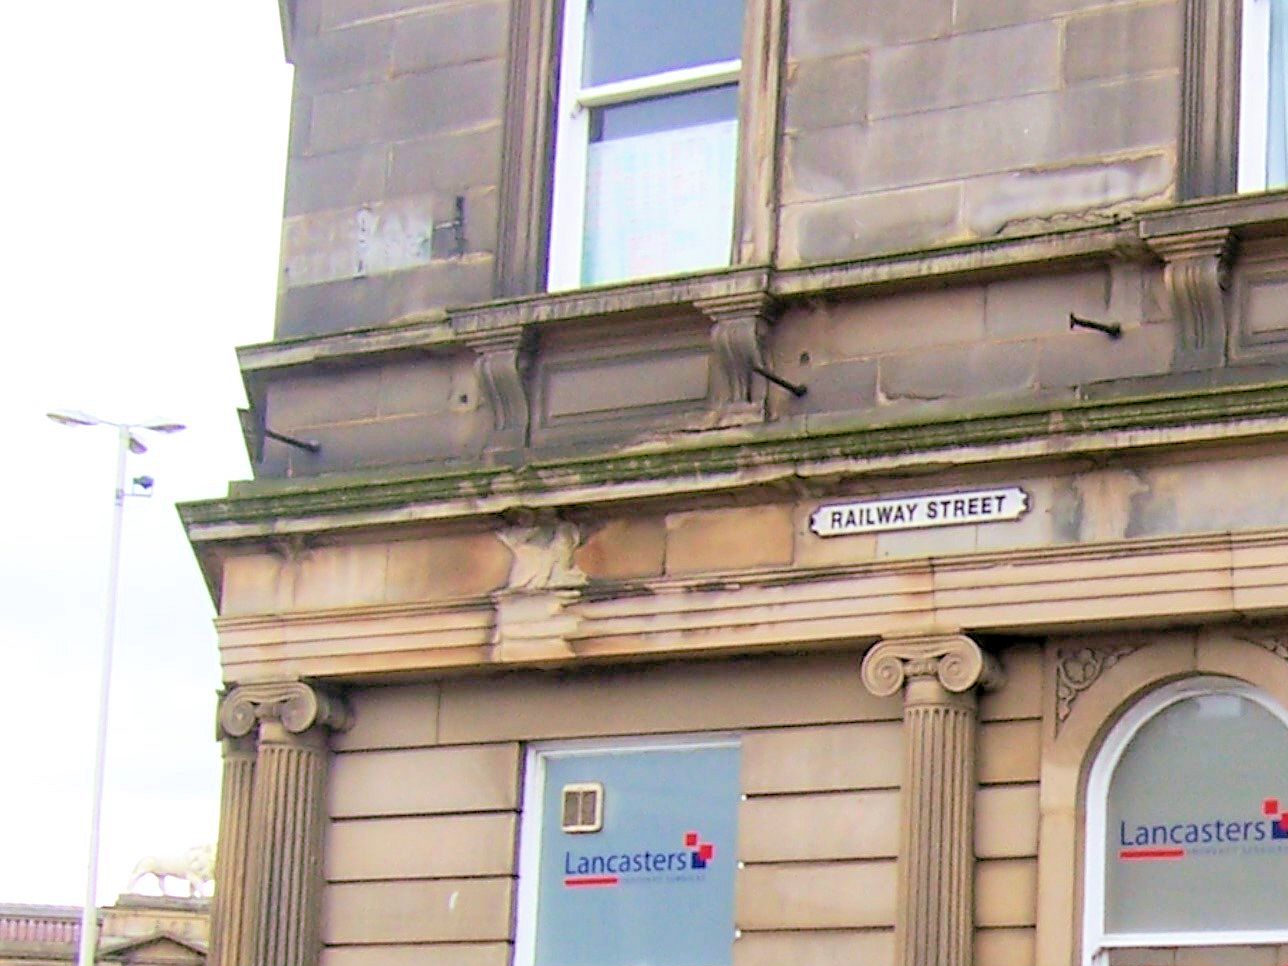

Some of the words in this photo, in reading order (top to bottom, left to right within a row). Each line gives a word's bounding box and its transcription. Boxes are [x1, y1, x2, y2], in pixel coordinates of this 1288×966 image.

[831, 504, 918, 529] RAILWAY
[927, 495, 1006, 519] STREET
[1120, 819, 1265, 846] Lancasters
[565, 850, 687, 875] Lancasters
